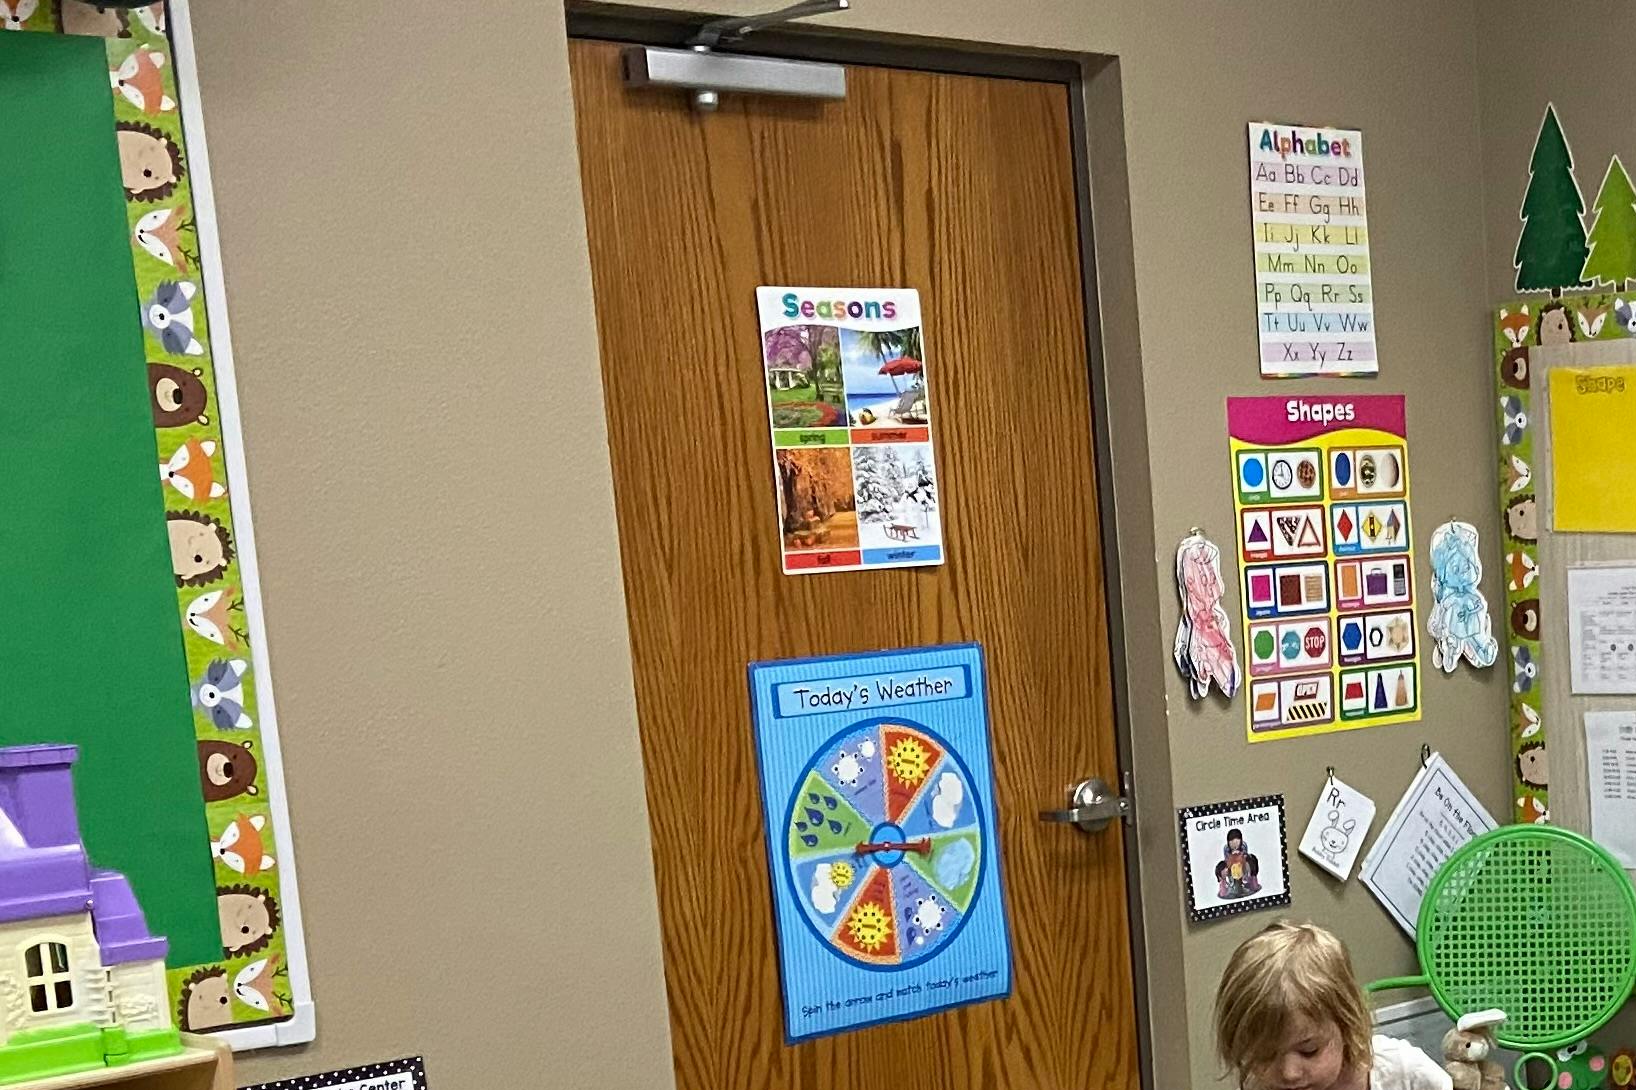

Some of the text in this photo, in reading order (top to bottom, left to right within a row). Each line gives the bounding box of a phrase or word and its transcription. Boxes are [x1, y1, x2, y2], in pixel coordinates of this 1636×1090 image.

[1260, 128, 1351, 160] Alphabet
[1256, 163, 1358, 187] Aa Bb Cc Dd
[1259, 192, 1359, 223] Ee Ff Gg Hh
[1264, 223, 1358, 252] Ii Jj Kk Ll
[1268, 254, 1357, 274] Mm Nn Oo
[782, 293, 896, 320] Seasons
[1265, 283, 1363, 311] Pp Qq Rr Ss
[1264, 313, 1368, 332] Tt Uu Vv Ww
[1284, 343, 1353, 367] Xx Yy Zz
[1575, 374, 1625, 395] Shape
[1286, 400, 1355, 426] Shapes
[1305, 636, 1325, 649] STOP
[794, 677, 952, 709] Today's Weather
[1326, 788, 1346, 809] Rr
[1196, 812, 1270, 831] Circle Time Area
